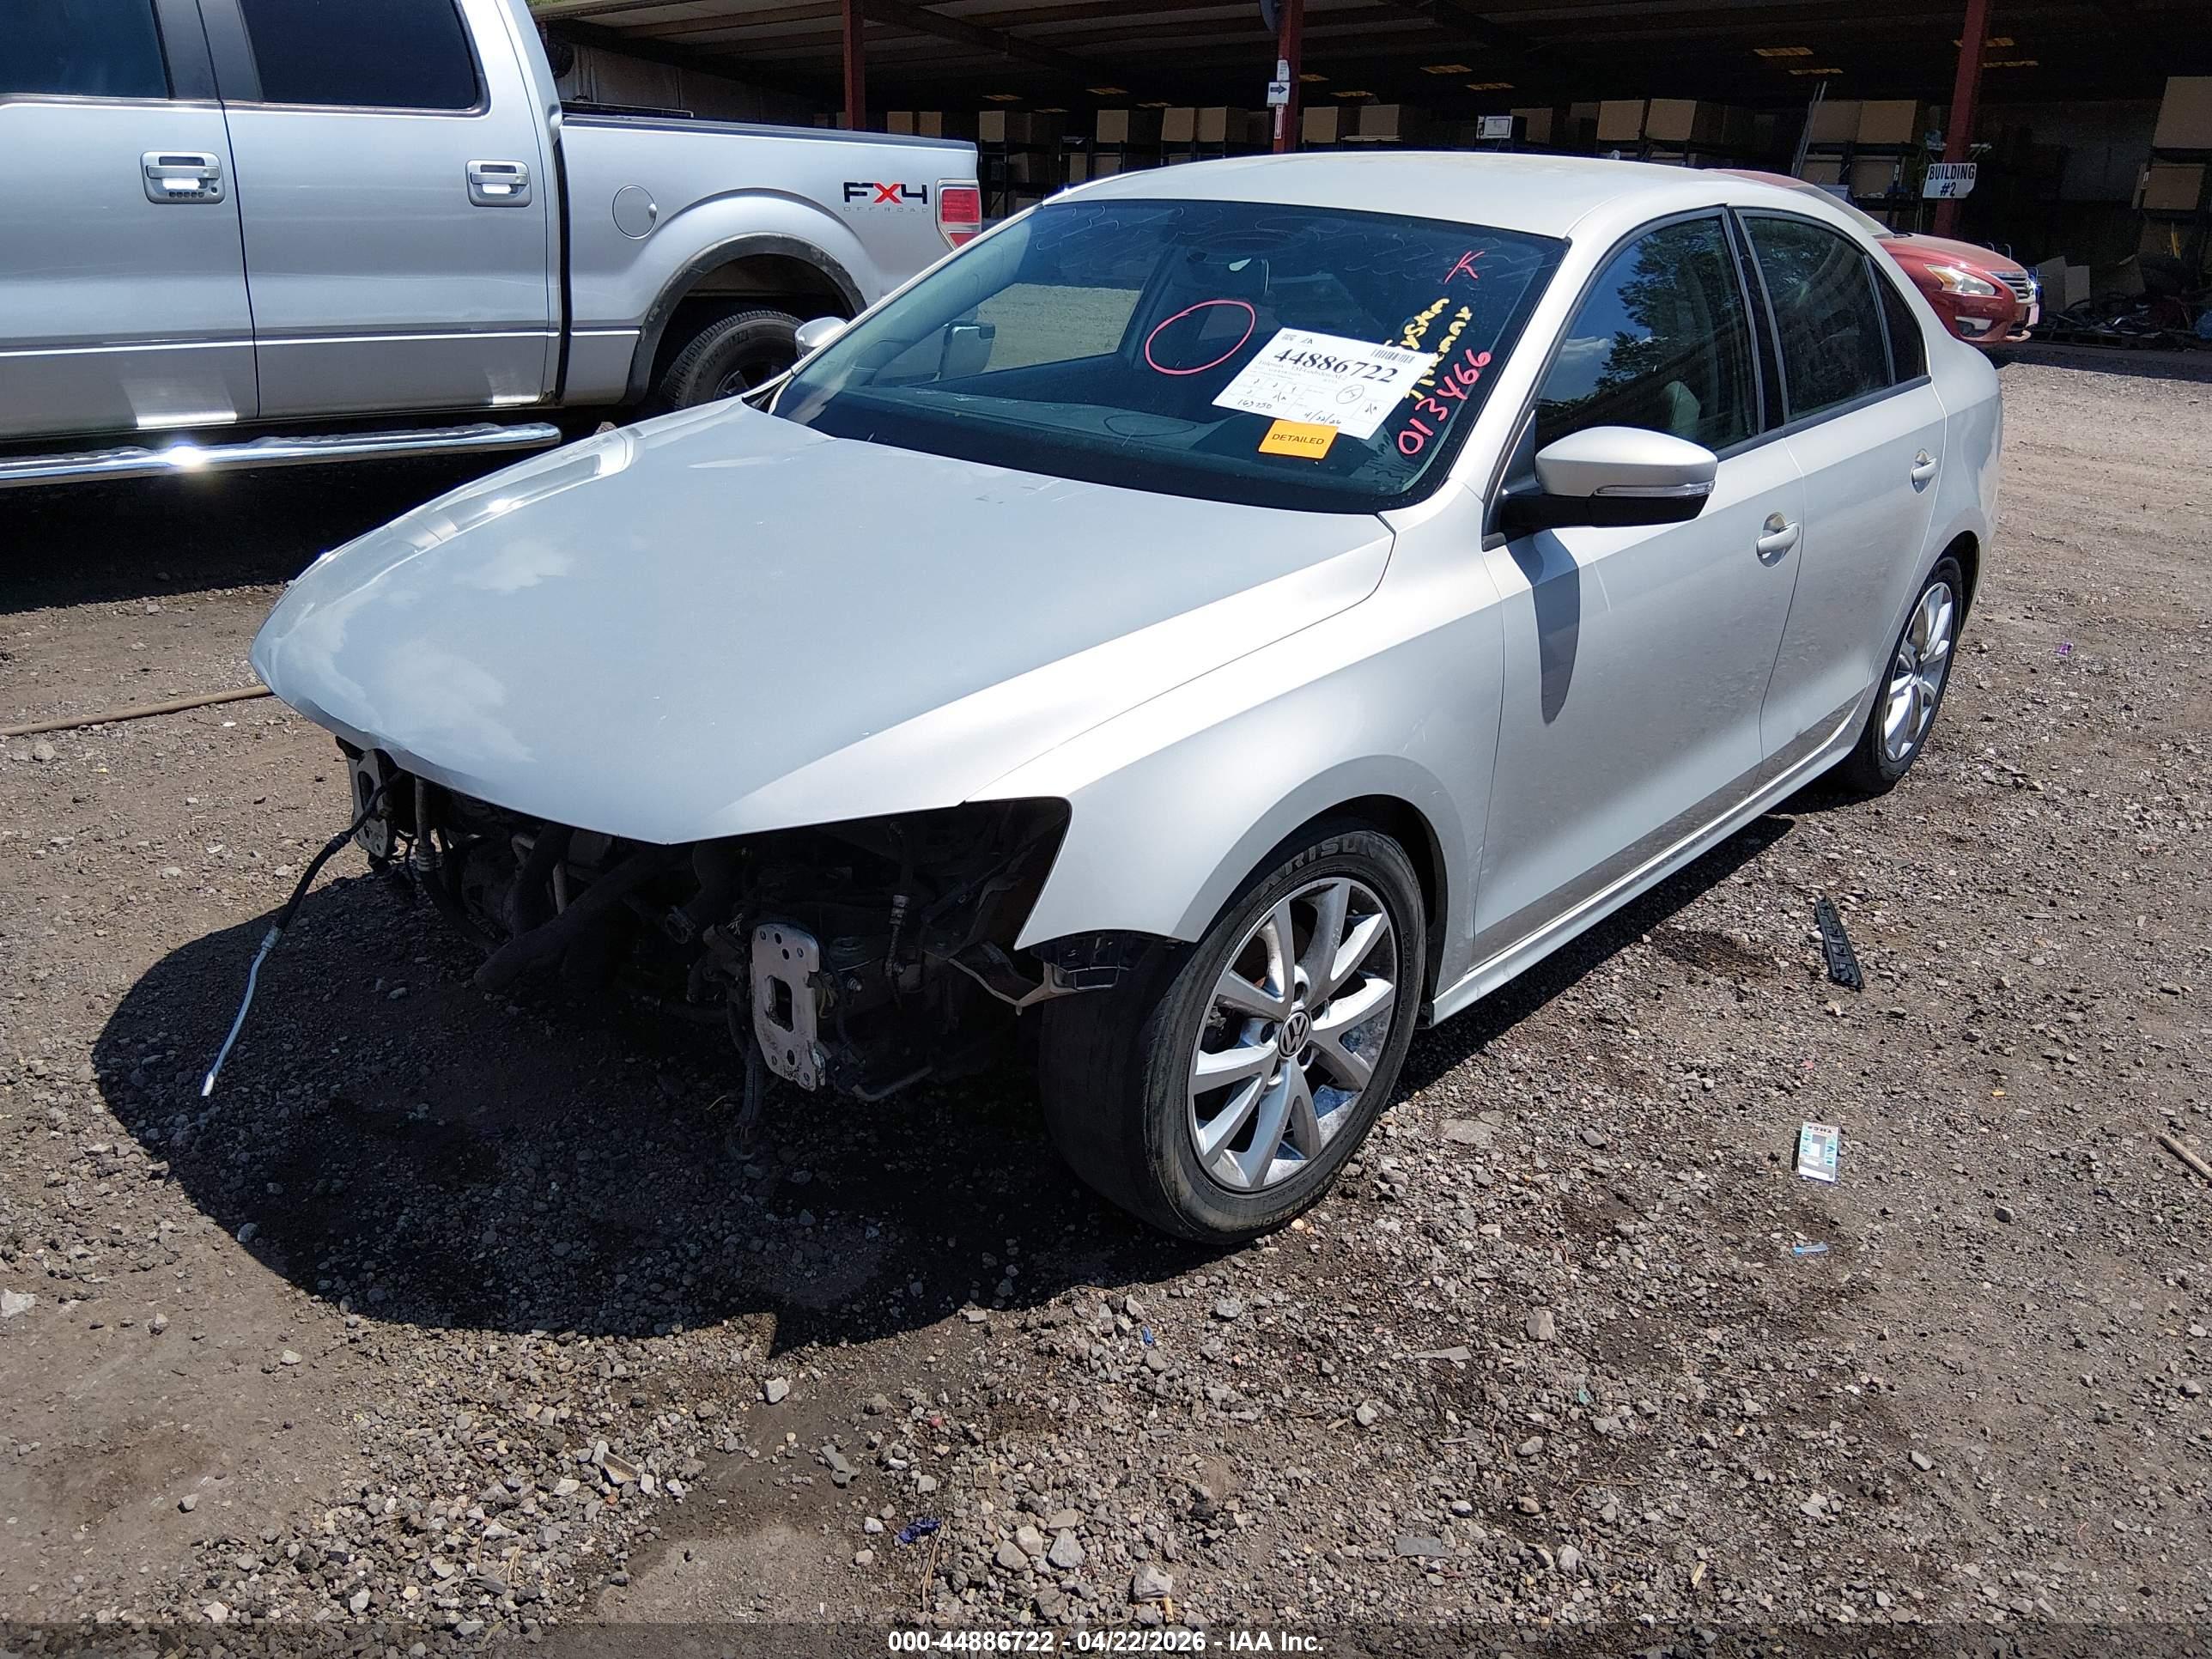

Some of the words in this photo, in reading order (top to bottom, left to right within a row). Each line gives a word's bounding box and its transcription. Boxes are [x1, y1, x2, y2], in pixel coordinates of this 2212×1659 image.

[1929, 164, 1975, 180] BUILDING
[843, 181, 928, 205] FX4
[1939, 181, 1957, 197] #2
[1273, 348, 1399, 384] 44886722
[1398, 349, 1492, 455] 013466
[1271, 433, 1325, 447] DETAILED
